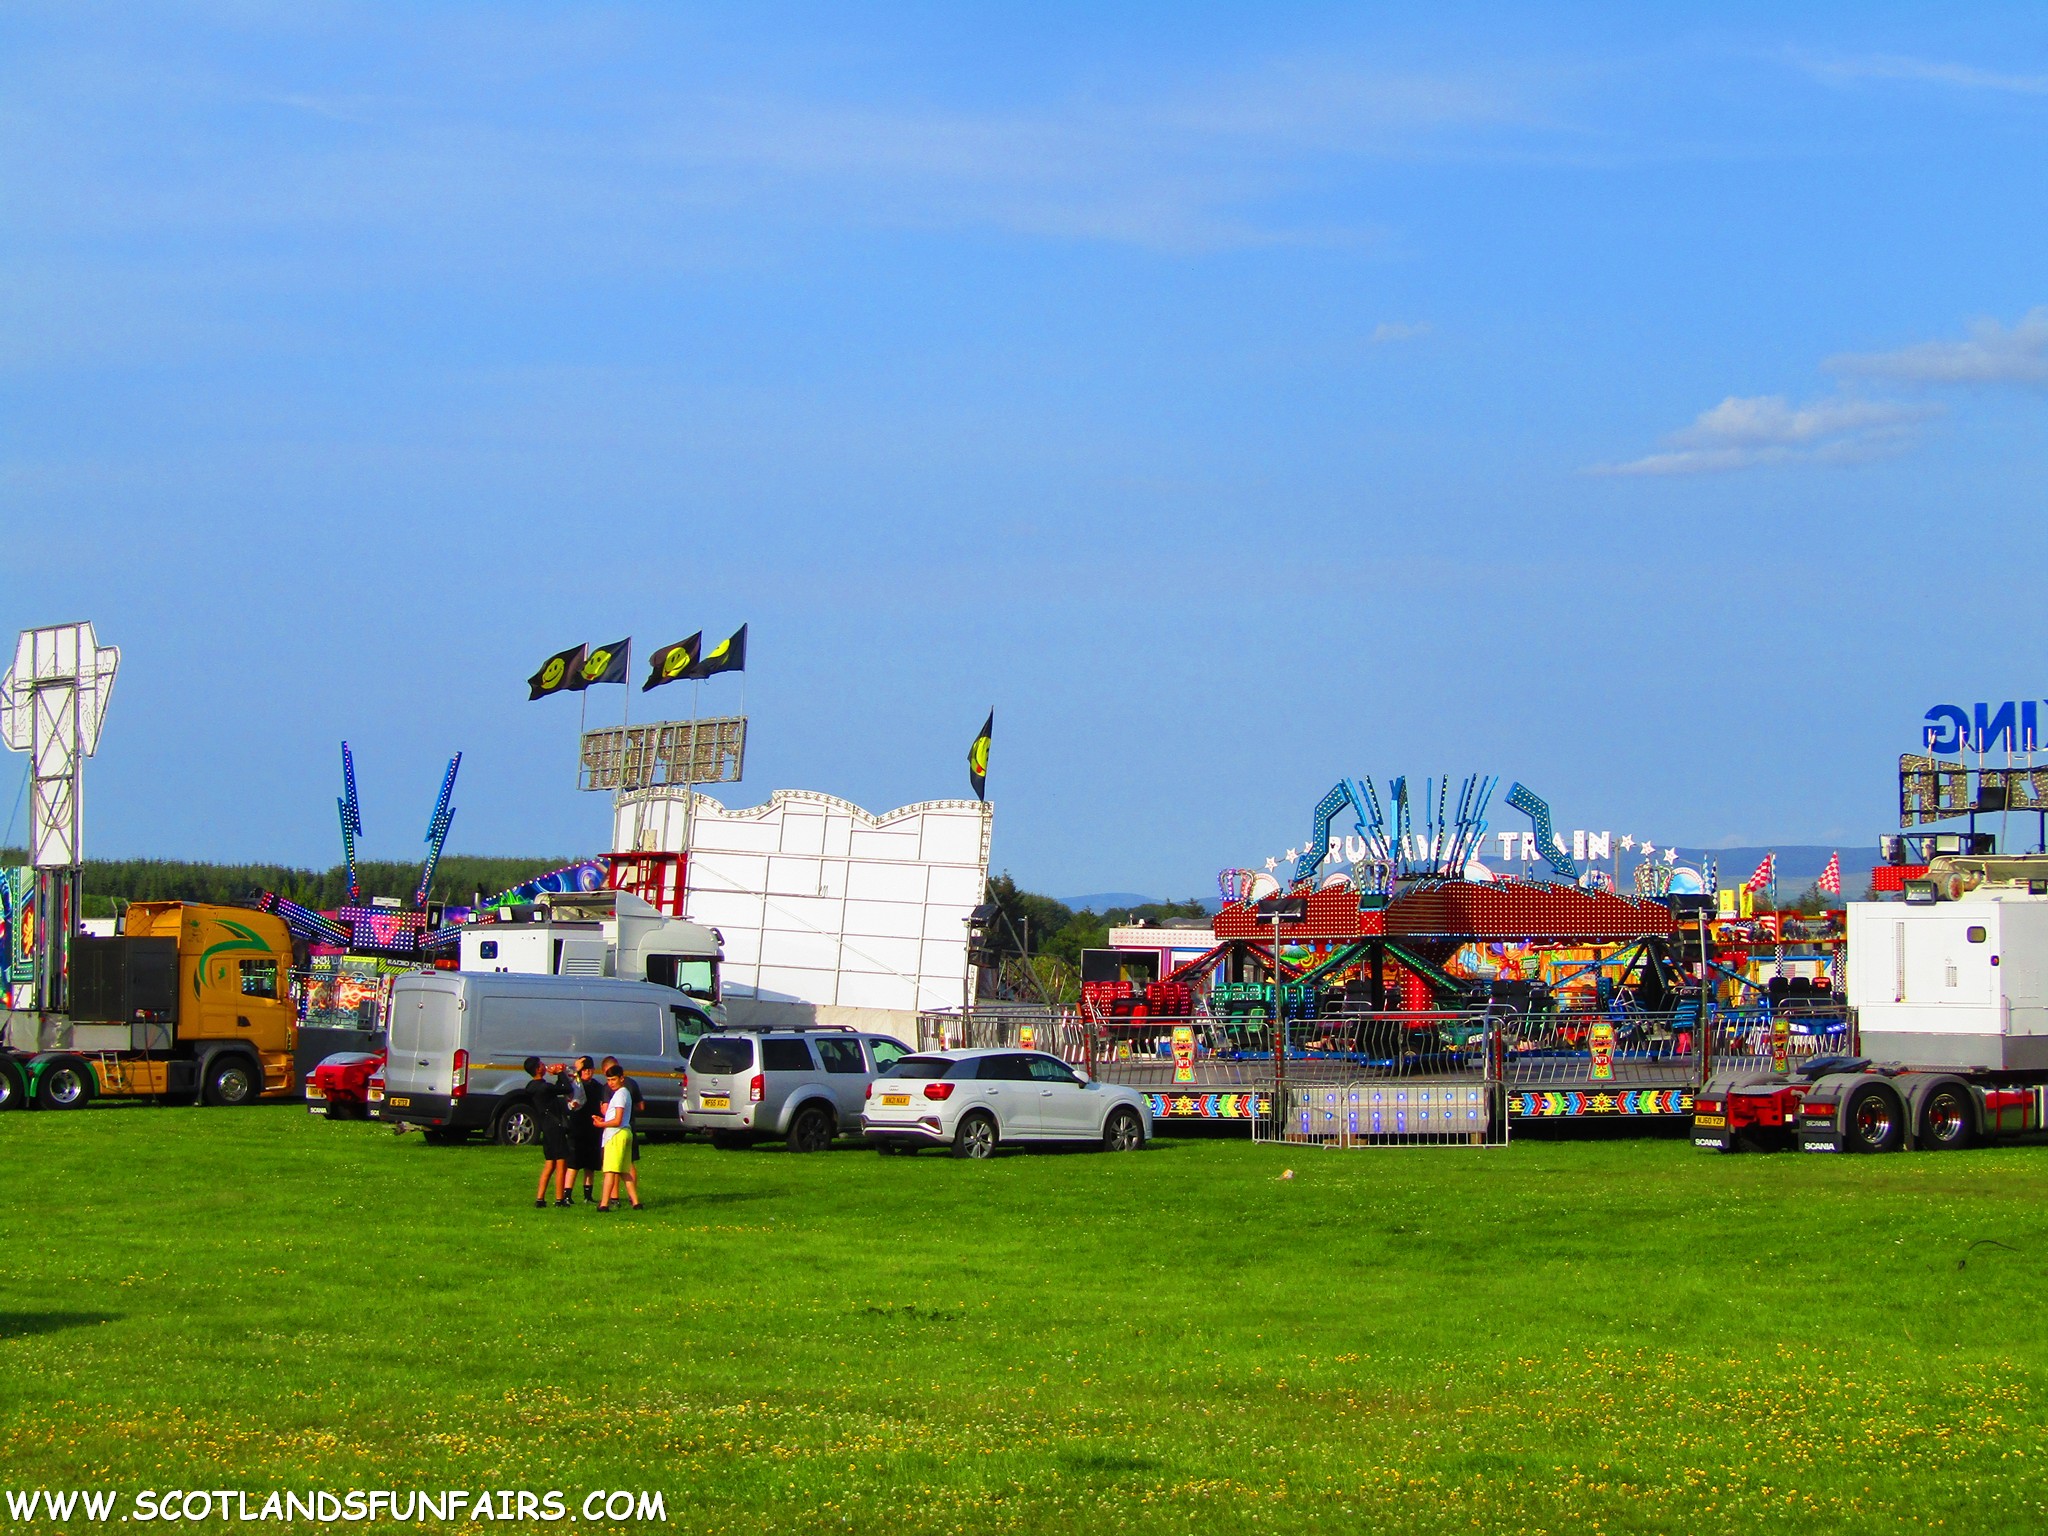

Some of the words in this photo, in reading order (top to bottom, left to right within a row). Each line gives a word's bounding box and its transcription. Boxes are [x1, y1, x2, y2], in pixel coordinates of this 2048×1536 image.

[387, 959, 409, 967] RADIO
[1697, 1117, 1712, 1125] NJ60
[1695, 1138, 1723, 1147] SCANIA
[1804, 1142, 1835, 1150] SCANIA
